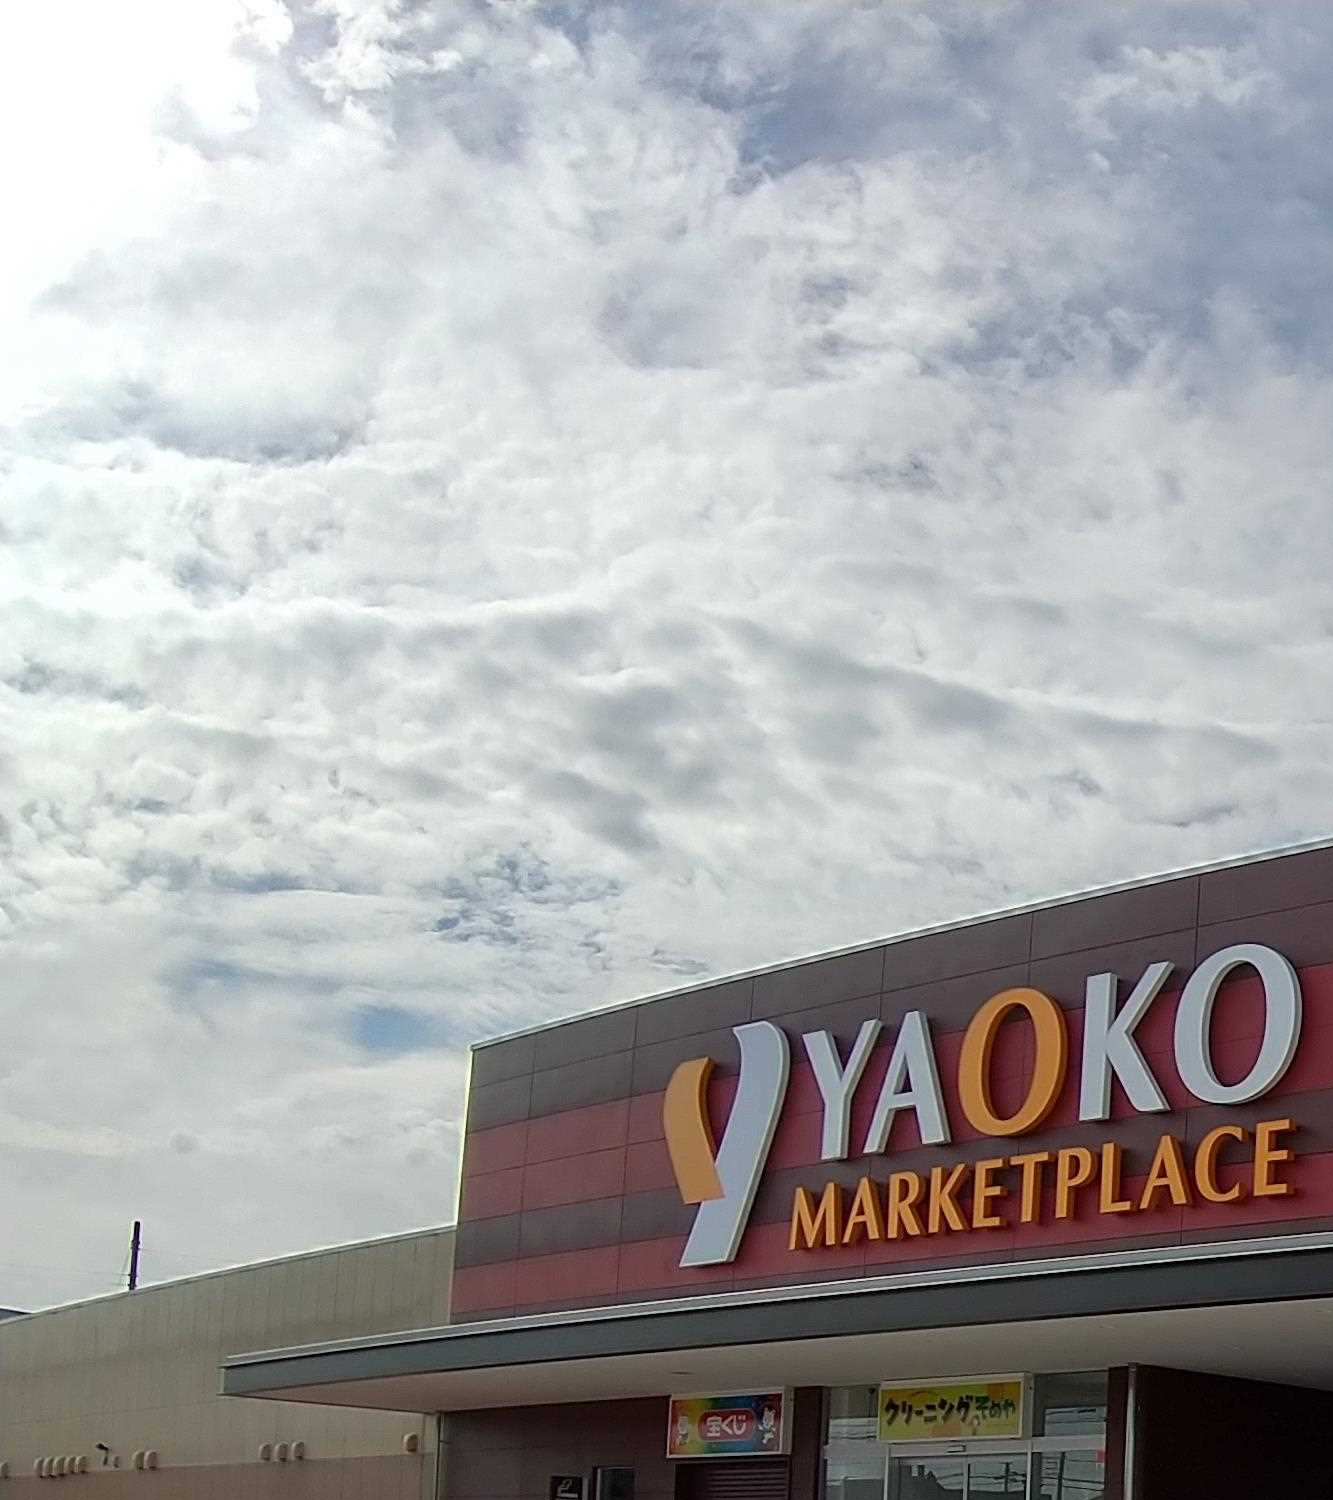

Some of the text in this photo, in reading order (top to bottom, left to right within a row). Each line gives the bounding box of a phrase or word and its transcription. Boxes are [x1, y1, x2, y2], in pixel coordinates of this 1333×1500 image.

[803, 943, 1303, 1161] YAOKO
[788, 1117, 1296, 1250] MARKETPLACE
[705, 1414, 748, 1438] 宝くじ
